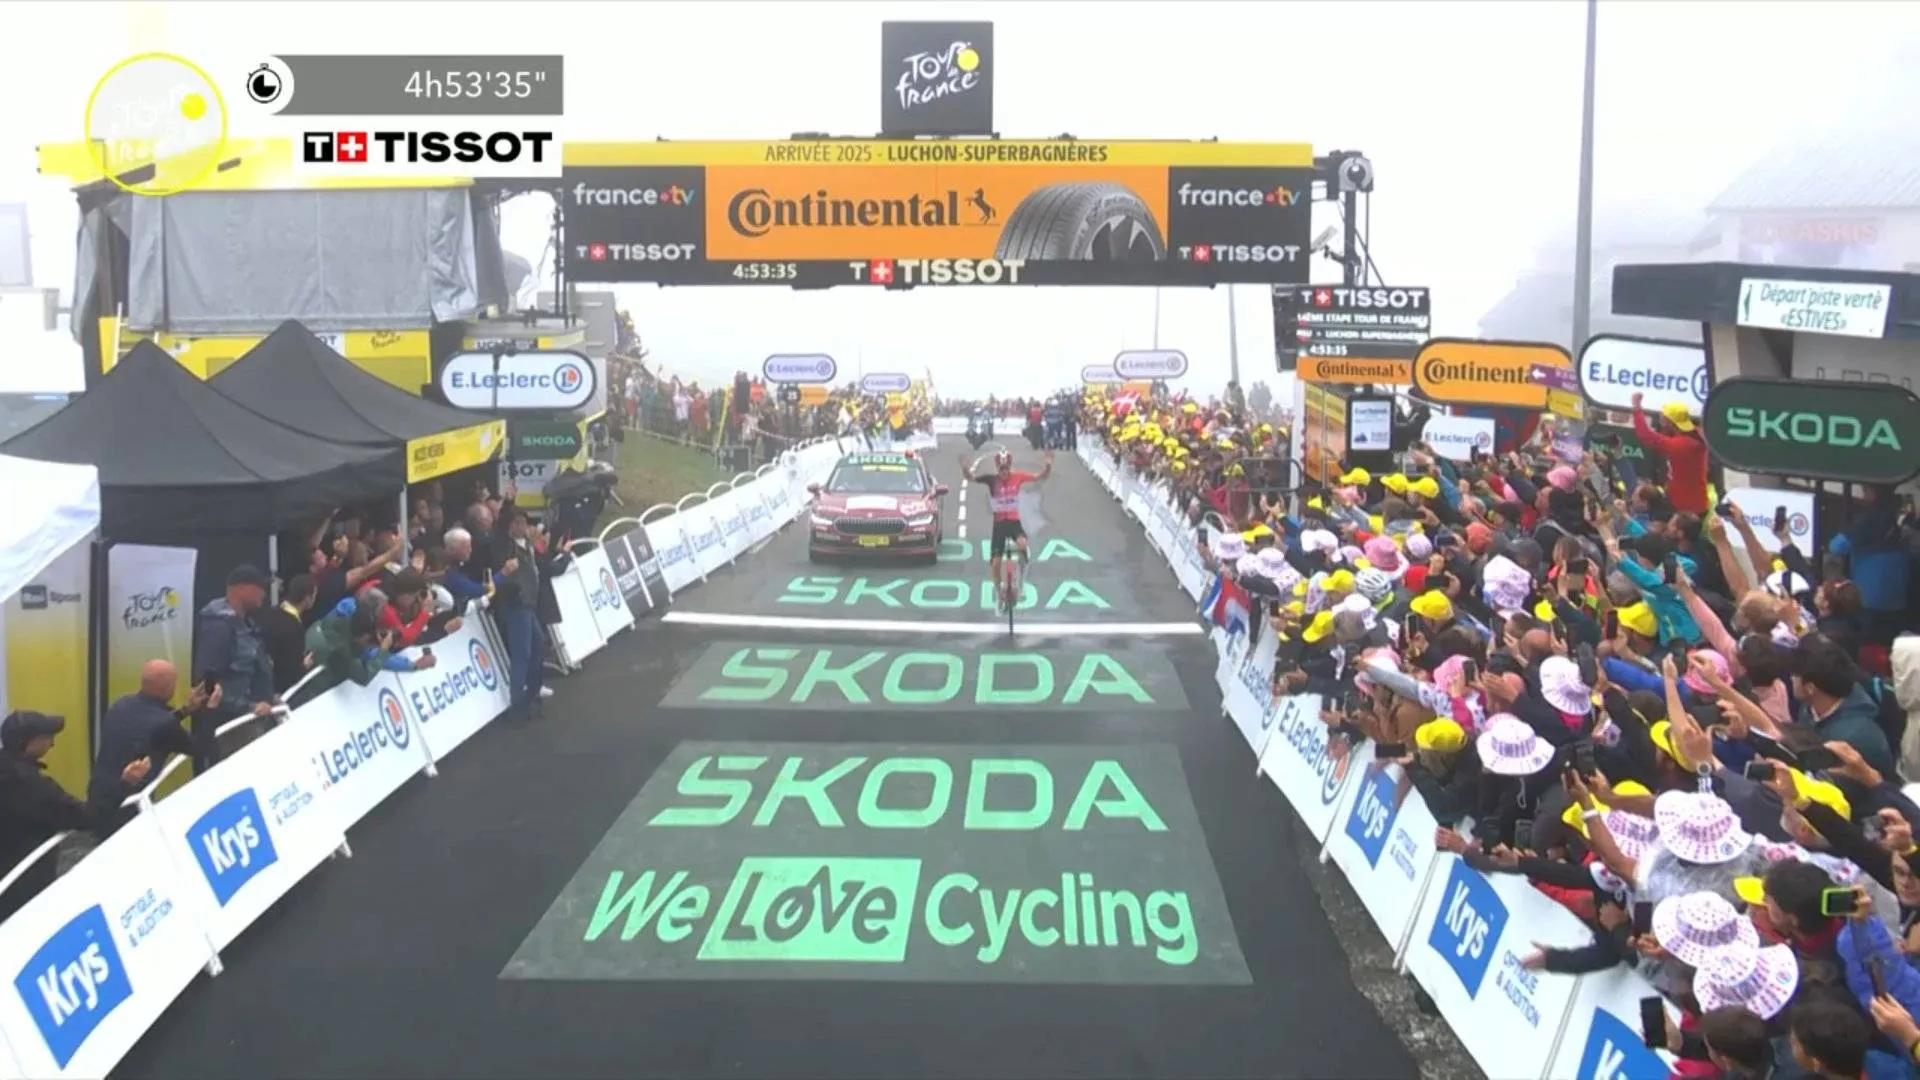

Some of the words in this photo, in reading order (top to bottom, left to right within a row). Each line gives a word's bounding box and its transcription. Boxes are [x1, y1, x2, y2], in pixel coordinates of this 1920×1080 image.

[765, 141, 831, 161] ARRIVÉE
[836, 146, 872, 161] 2025
[887, 144, 1108, 162] LUCHON-SUPERBAGNÈRES
[728, 189, 960, 238] Continental
[608, 244, 695, 261] TISSOT
[1211, 245, 1300, 262] TISSOT
[733, 264, 797, 280] 4:53:35
[903, 260, 1025, 283] TISSOT
[1333, 289, 1424, 308] TISSOT
[1760, 283, 1807, 306] Départ
[1808, 287, 1841, 309] piste
[451, 371, 550, 388] E.Leclerc
[1316, 361, 1394, 378] Continental
[1424, 357, 1530, 384] Continent
[1589, 361, 1688, 392] E.Leclerc
[410, 661, 480, 724] E.Leclerc
[1279, 700, 1327, 778] E.Leclerc
[1357, 779, 1390, 840] Krys
[203, 816, 260, 876] Krys
[583, 871, 710, 943] We
[925, 872, 1199, 965] Cycling
[1444, 880, 1489, 960] Krys
[36, 942, 109, 1027] Krys
[1502, 979, 1540, 1029] AUDITION
